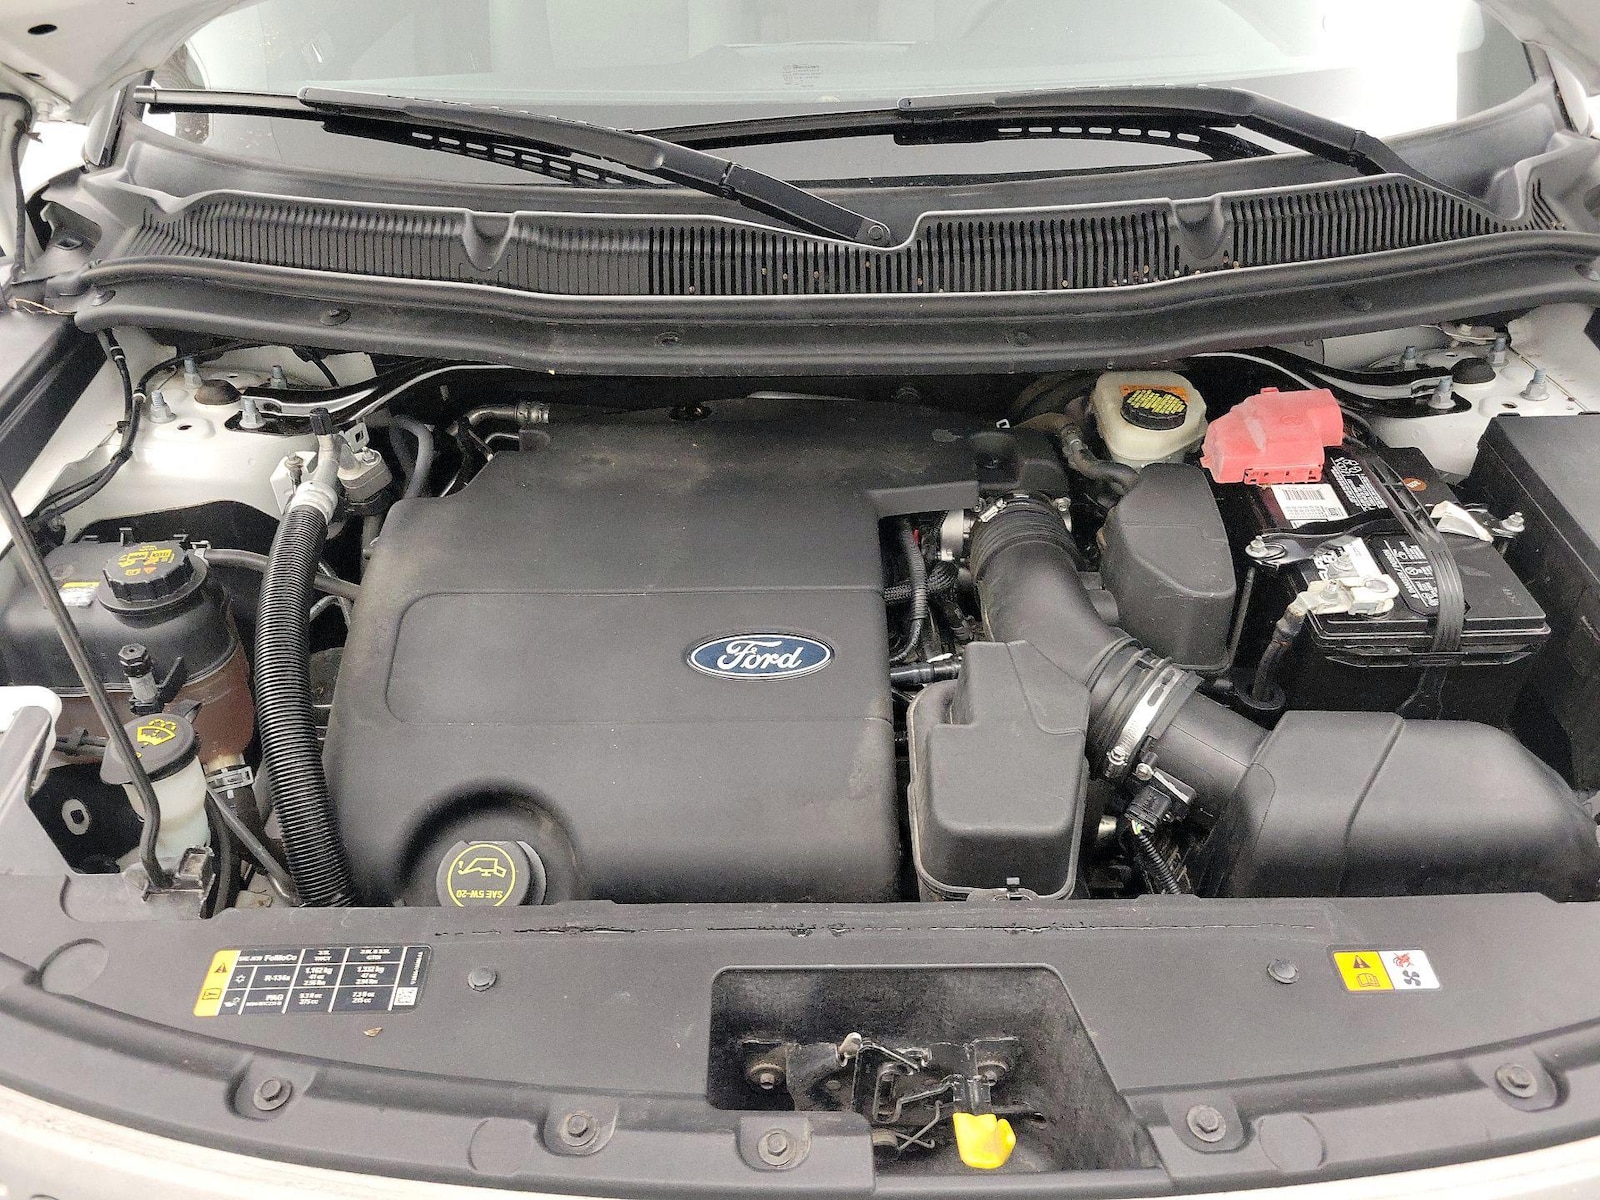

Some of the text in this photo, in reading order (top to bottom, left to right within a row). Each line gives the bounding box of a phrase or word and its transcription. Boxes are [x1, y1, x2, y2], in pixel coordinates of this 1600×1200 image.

[717, 640, 804, 670] Ford
[456, 890, 503, 898] SAE 5W-20
[263, 954, 298, 962] FoMoCo
[263, 974, 291, 982] R-134a
[265, 993, 285, 1001] PAG
